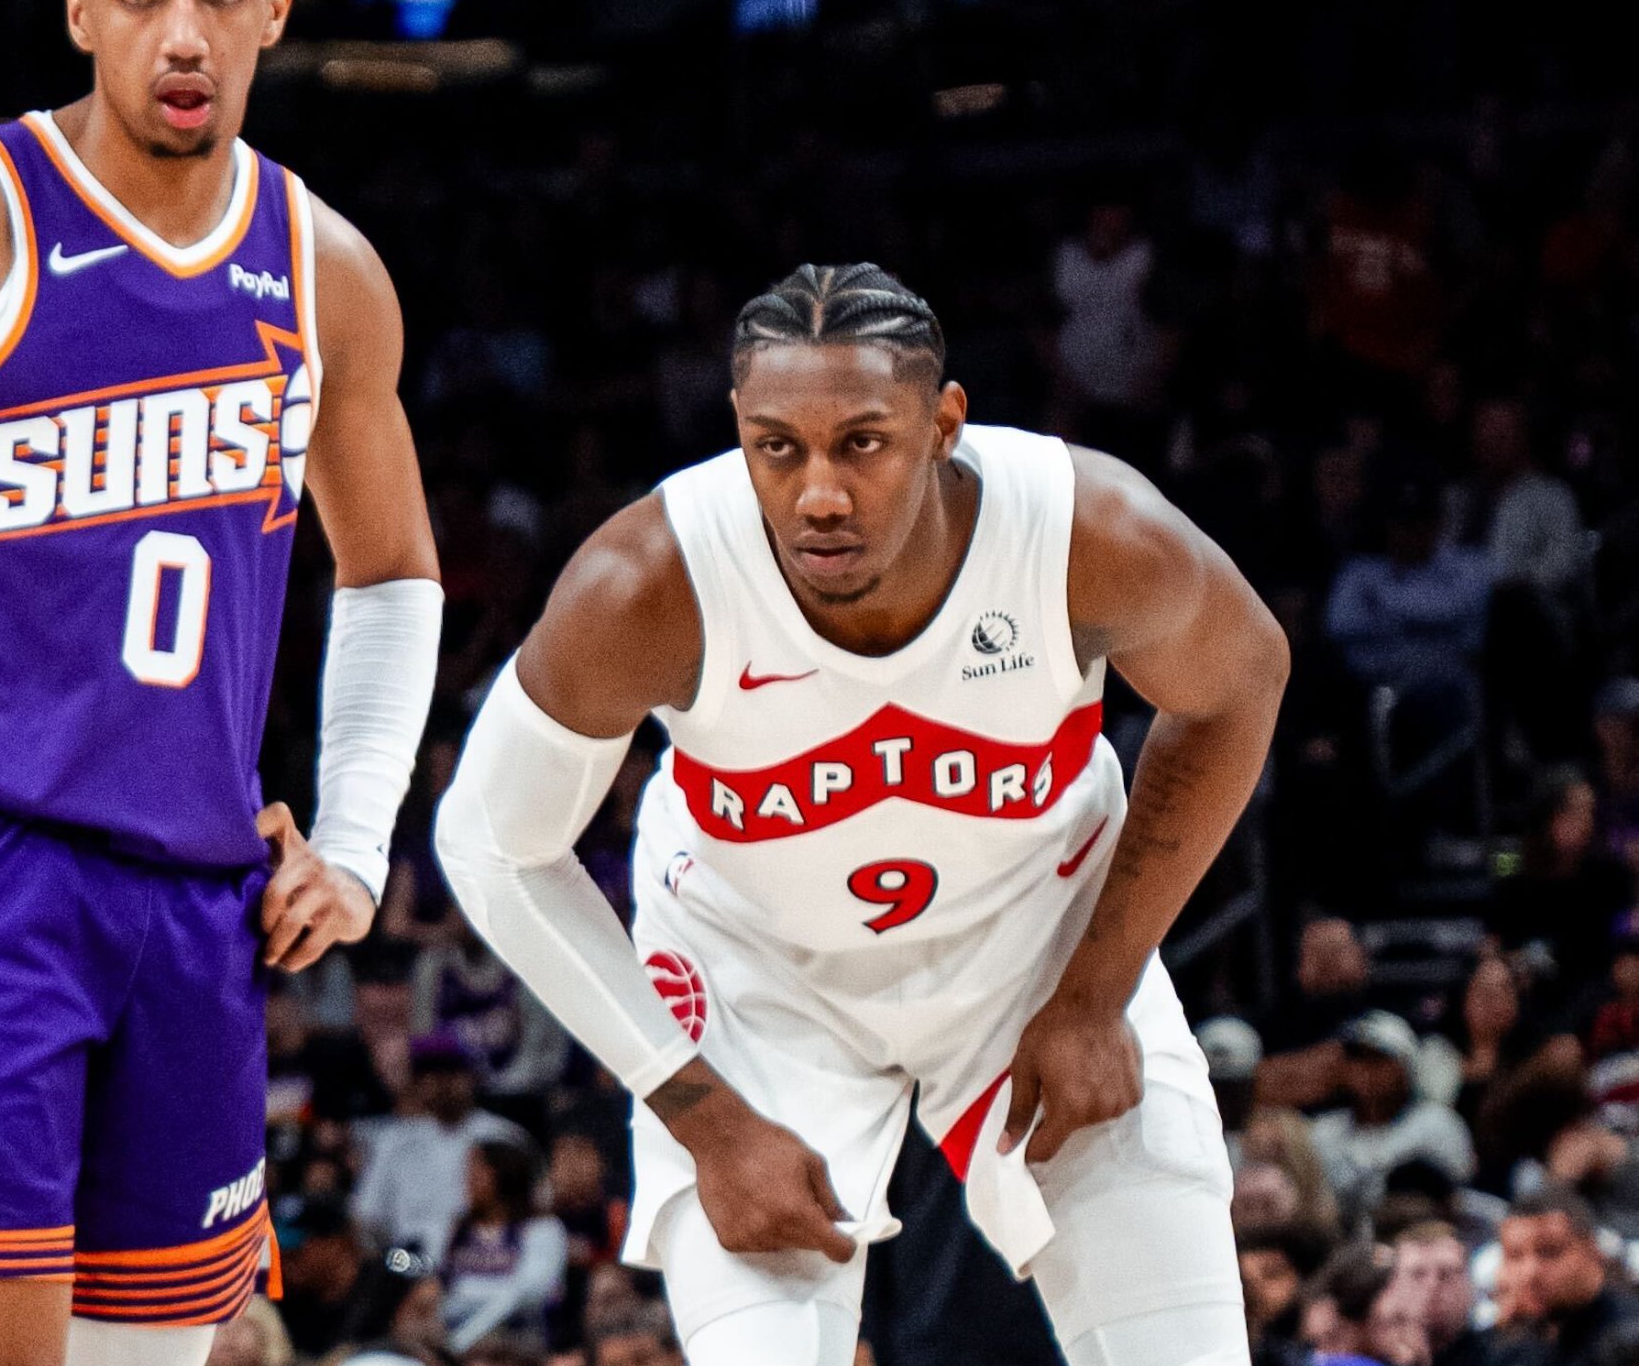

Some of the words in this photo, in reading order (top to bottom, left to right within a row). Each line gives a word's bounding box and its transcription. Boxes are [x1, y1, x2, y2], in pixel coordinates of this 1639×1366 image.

[229, 263, 290, 299] PayPal
[122, 530, 212, 689] 0
[962, 663, 996, 681] Sun
[1000, 652, 1034, 672] Life
[710, 736, 1054, 832] RAPTORS
[847, 856, 939, 935] 9
